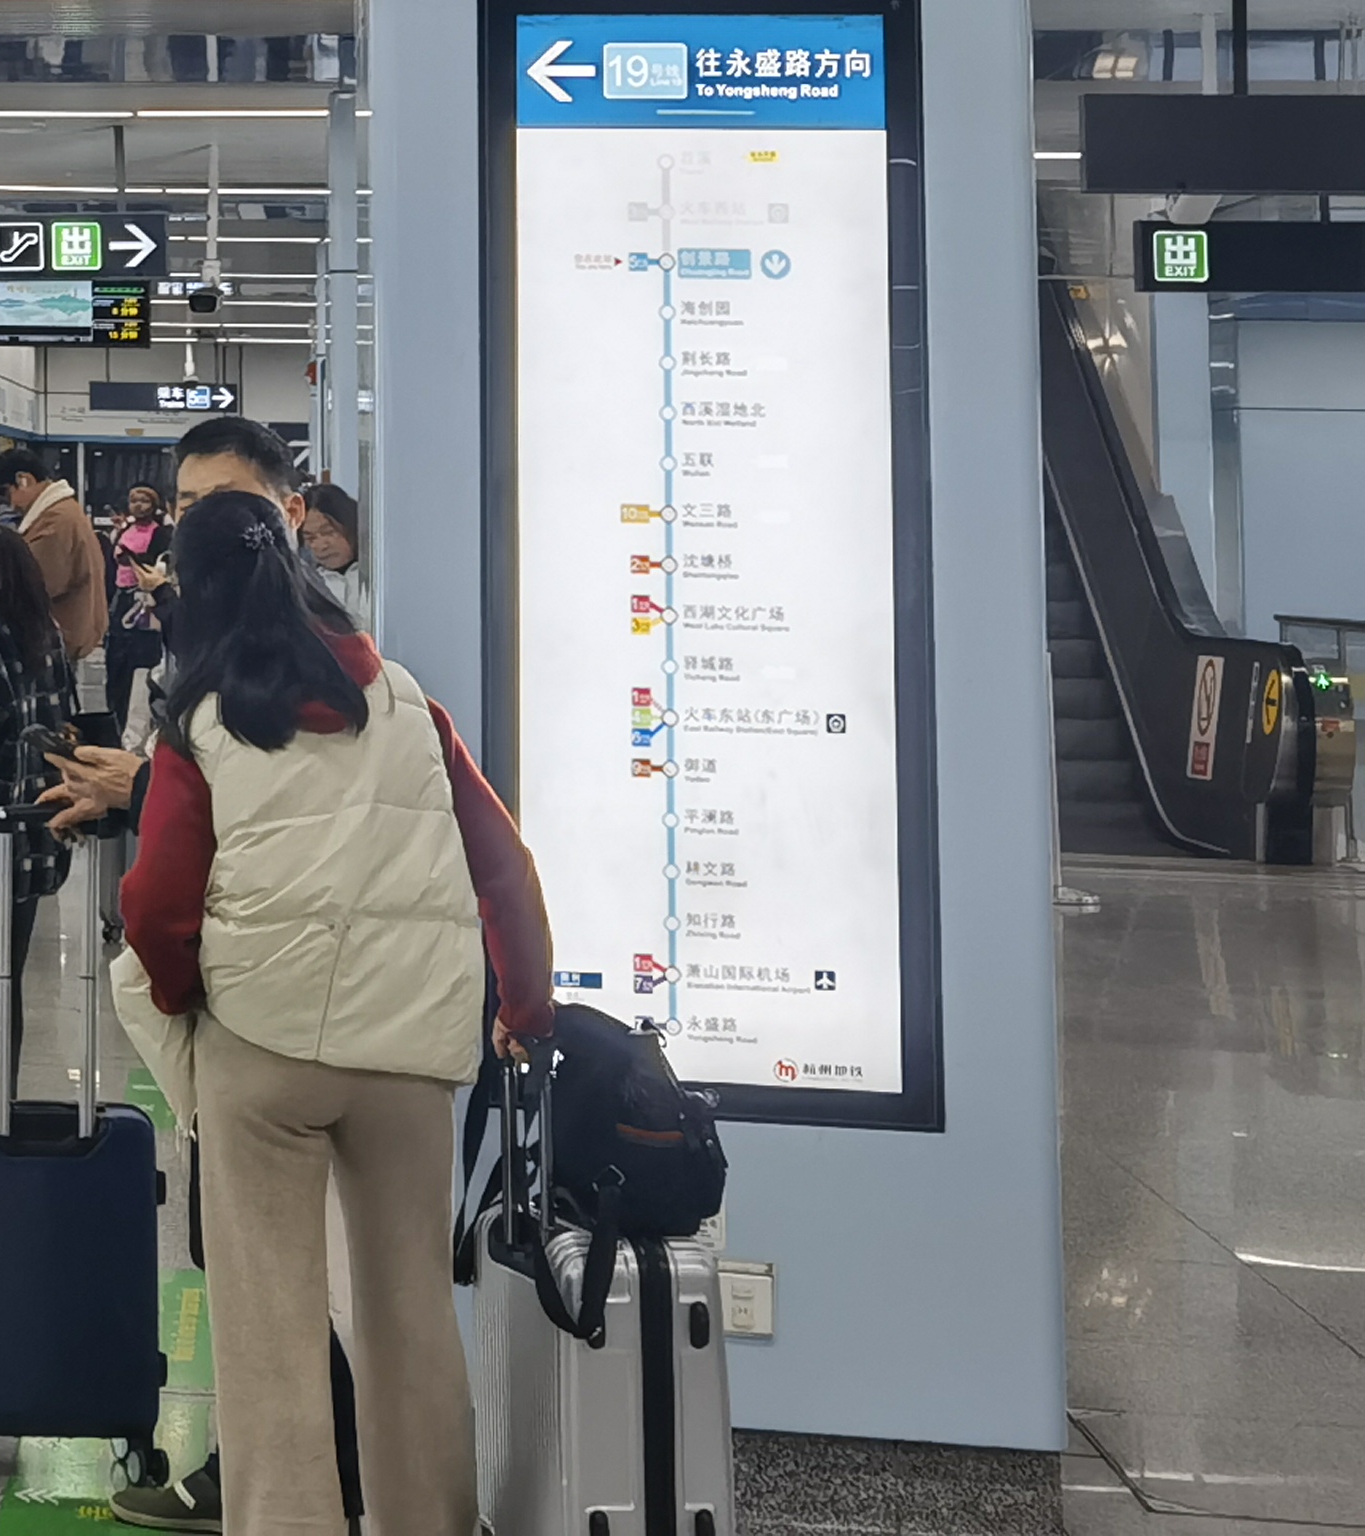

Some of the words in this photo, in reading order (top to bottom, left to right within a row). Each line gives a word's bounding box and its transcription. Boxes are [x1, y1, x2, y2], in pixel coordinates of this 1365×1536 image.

[695, 48, 871, 78] 往永盛路方向
[696, 83, 714, 97] To
[718, 83, 798, 99] Yongsheng
[800, 83, 839, 97] Road
[60, 254, 92, 266] EXIT
[680, 250, 731, 266] 创景路
[1164, 265, 1197, 277] EXIT
[681, 300, 731, 316] 海创园
[681, 401, 767, 418] 西溪湿地北
[682, 452, 715, 468] 五联
[682, 503, 732, 518] 文三路
[683, 604, 785, 621] 西湖文化广场
[685, 912, 736, 929] 知行路
[685, 963, 791, 983] 萧山国际机场
[687, 1015, 738, 1033] 永盛路
